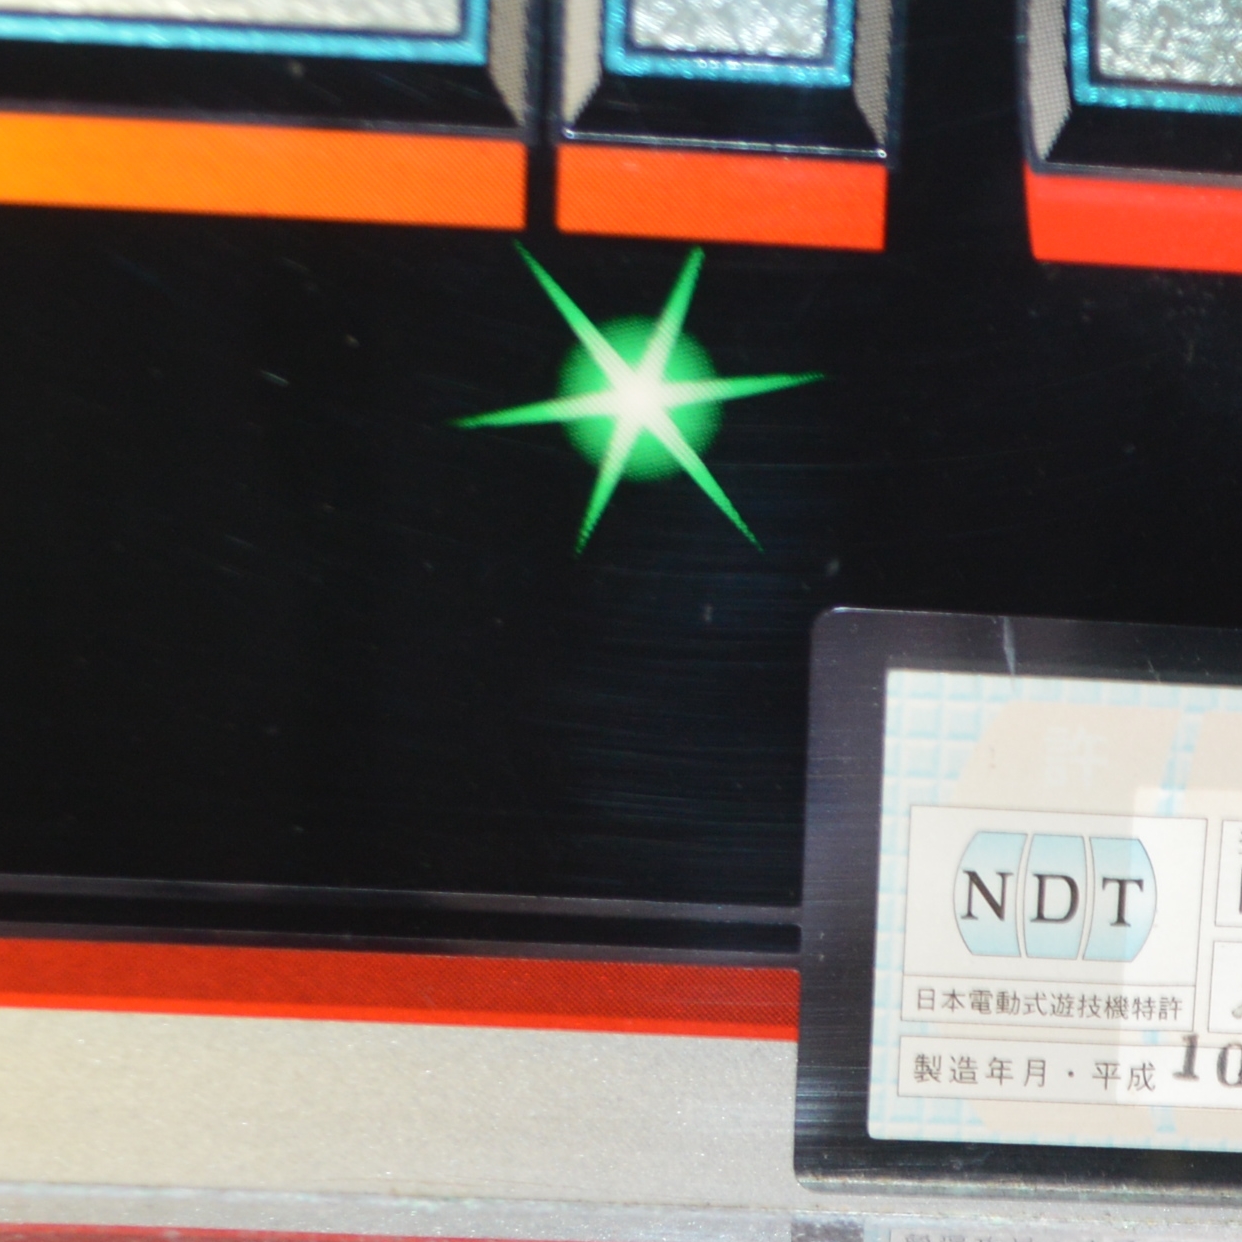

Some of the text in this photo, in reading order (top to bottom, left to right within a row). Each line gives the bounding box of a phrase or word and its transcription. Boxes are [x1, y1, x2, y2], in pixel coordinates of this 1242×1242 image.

[960, 869, 1145, 928] NDT
[916, 987, 1183, 1021] 日本電動式遊技機特許
